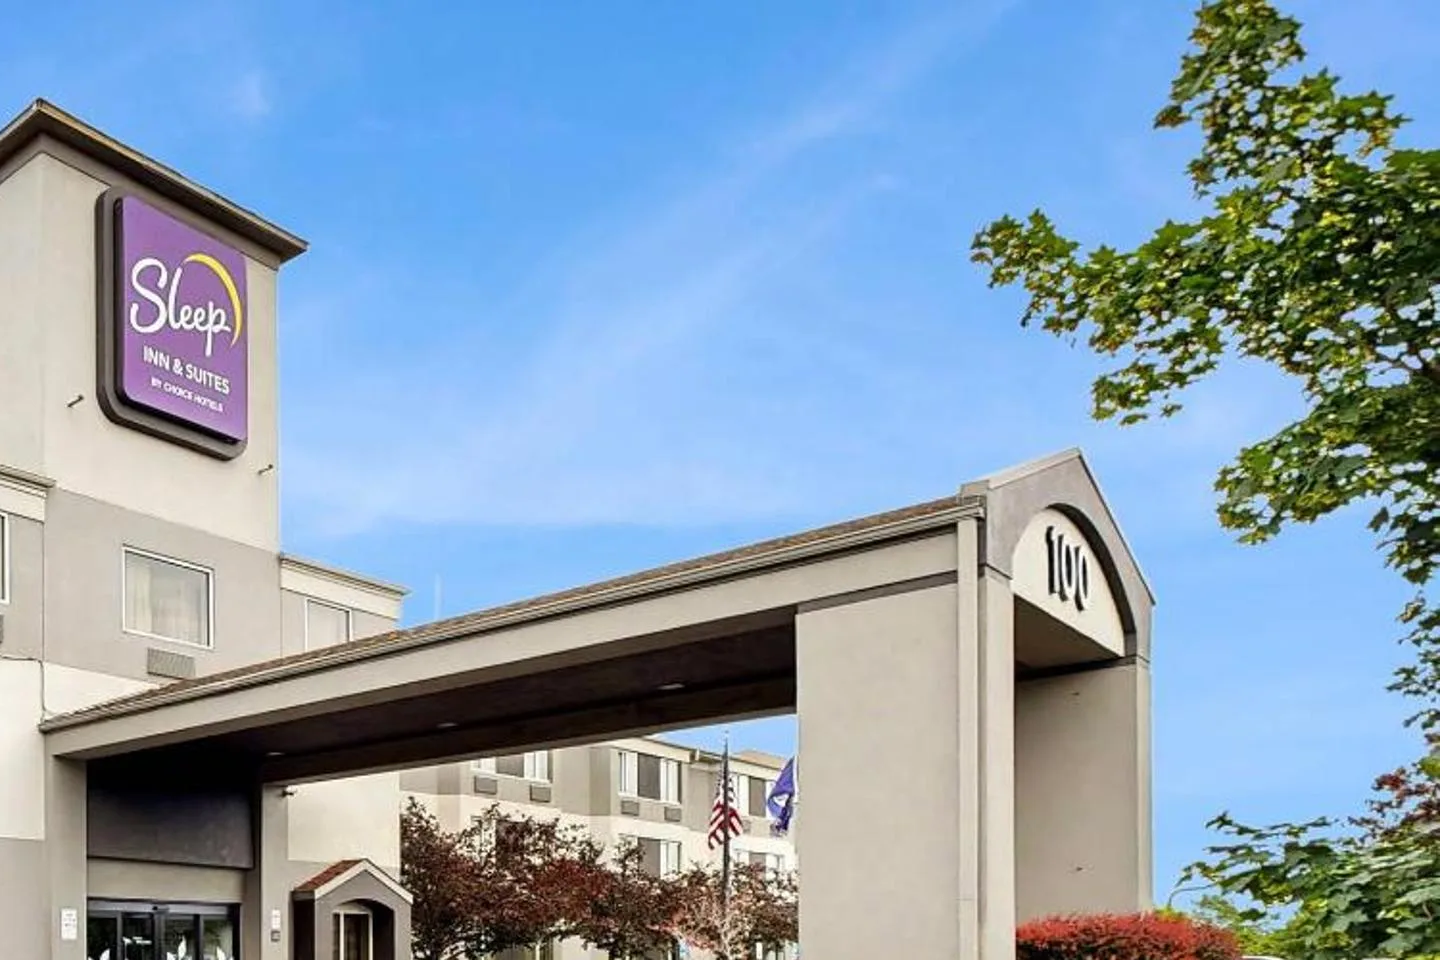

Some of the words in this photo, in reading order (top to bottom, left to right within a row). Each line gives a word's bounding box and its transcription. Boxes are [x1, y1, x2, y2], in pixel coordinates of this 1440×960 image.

[129, 257, 231, 357] Sleep
[143, 344, 170, 371] INN
[172, 358, 183, 376] &
[185, 363, 230, 395] SUITES
